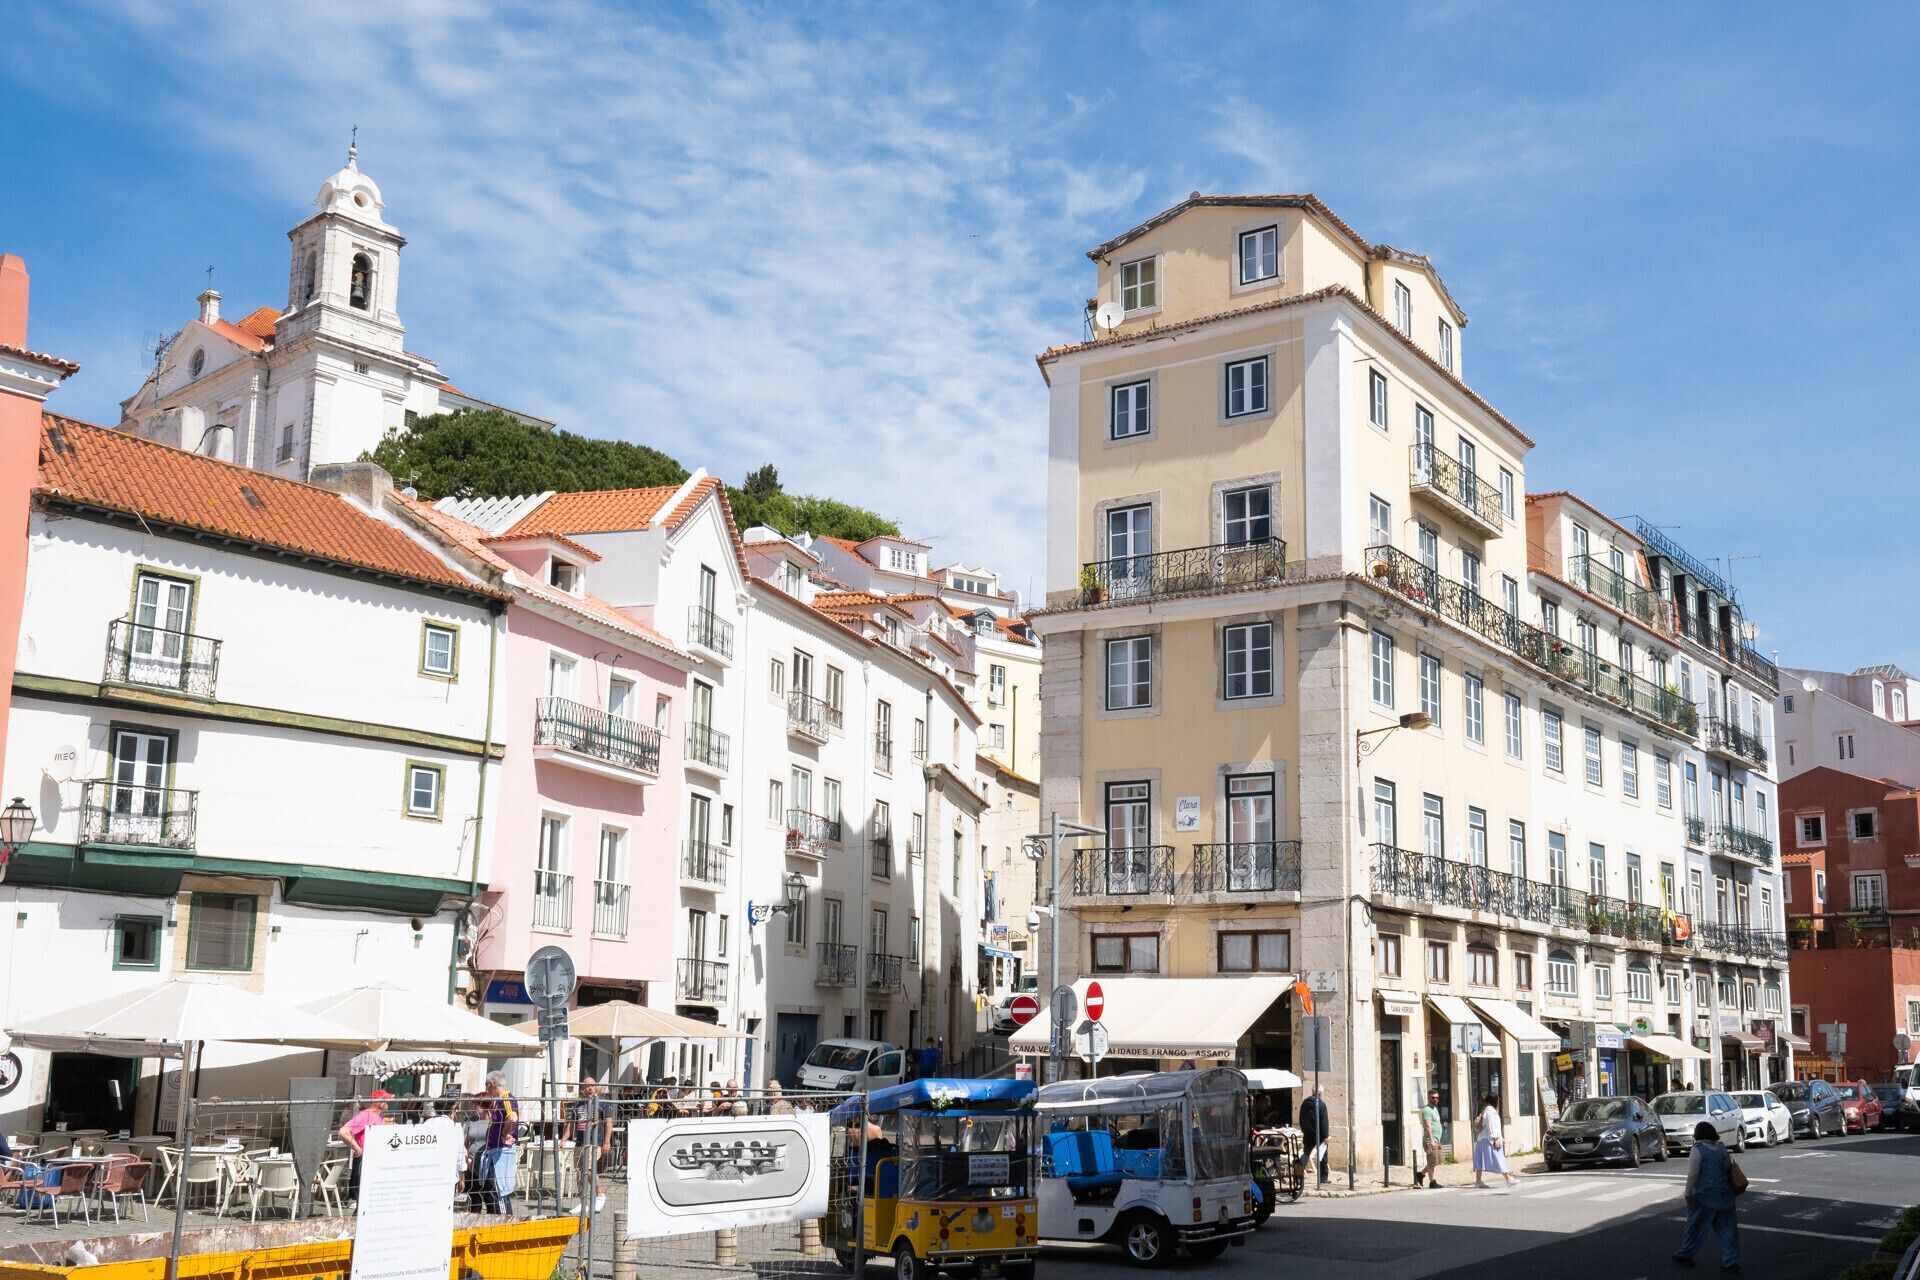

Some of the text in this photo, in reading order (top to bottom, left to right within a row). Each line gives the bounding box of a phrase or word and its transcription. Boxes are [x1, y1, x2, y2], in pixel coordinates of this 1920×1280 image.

[54, 751, 76, 761] MEO
[1179, 799, 1198, 812] Clara
[1012, 1045, 1036, 1053] CANA
[1107, 1048, 1147, 1056] ALIDADES
[1151, 1049, 1187, 1057] FRANGO
[1195, 1050, 1230, 1058] ASSADO
[405, 1134, 438, 1145] LISBOA
